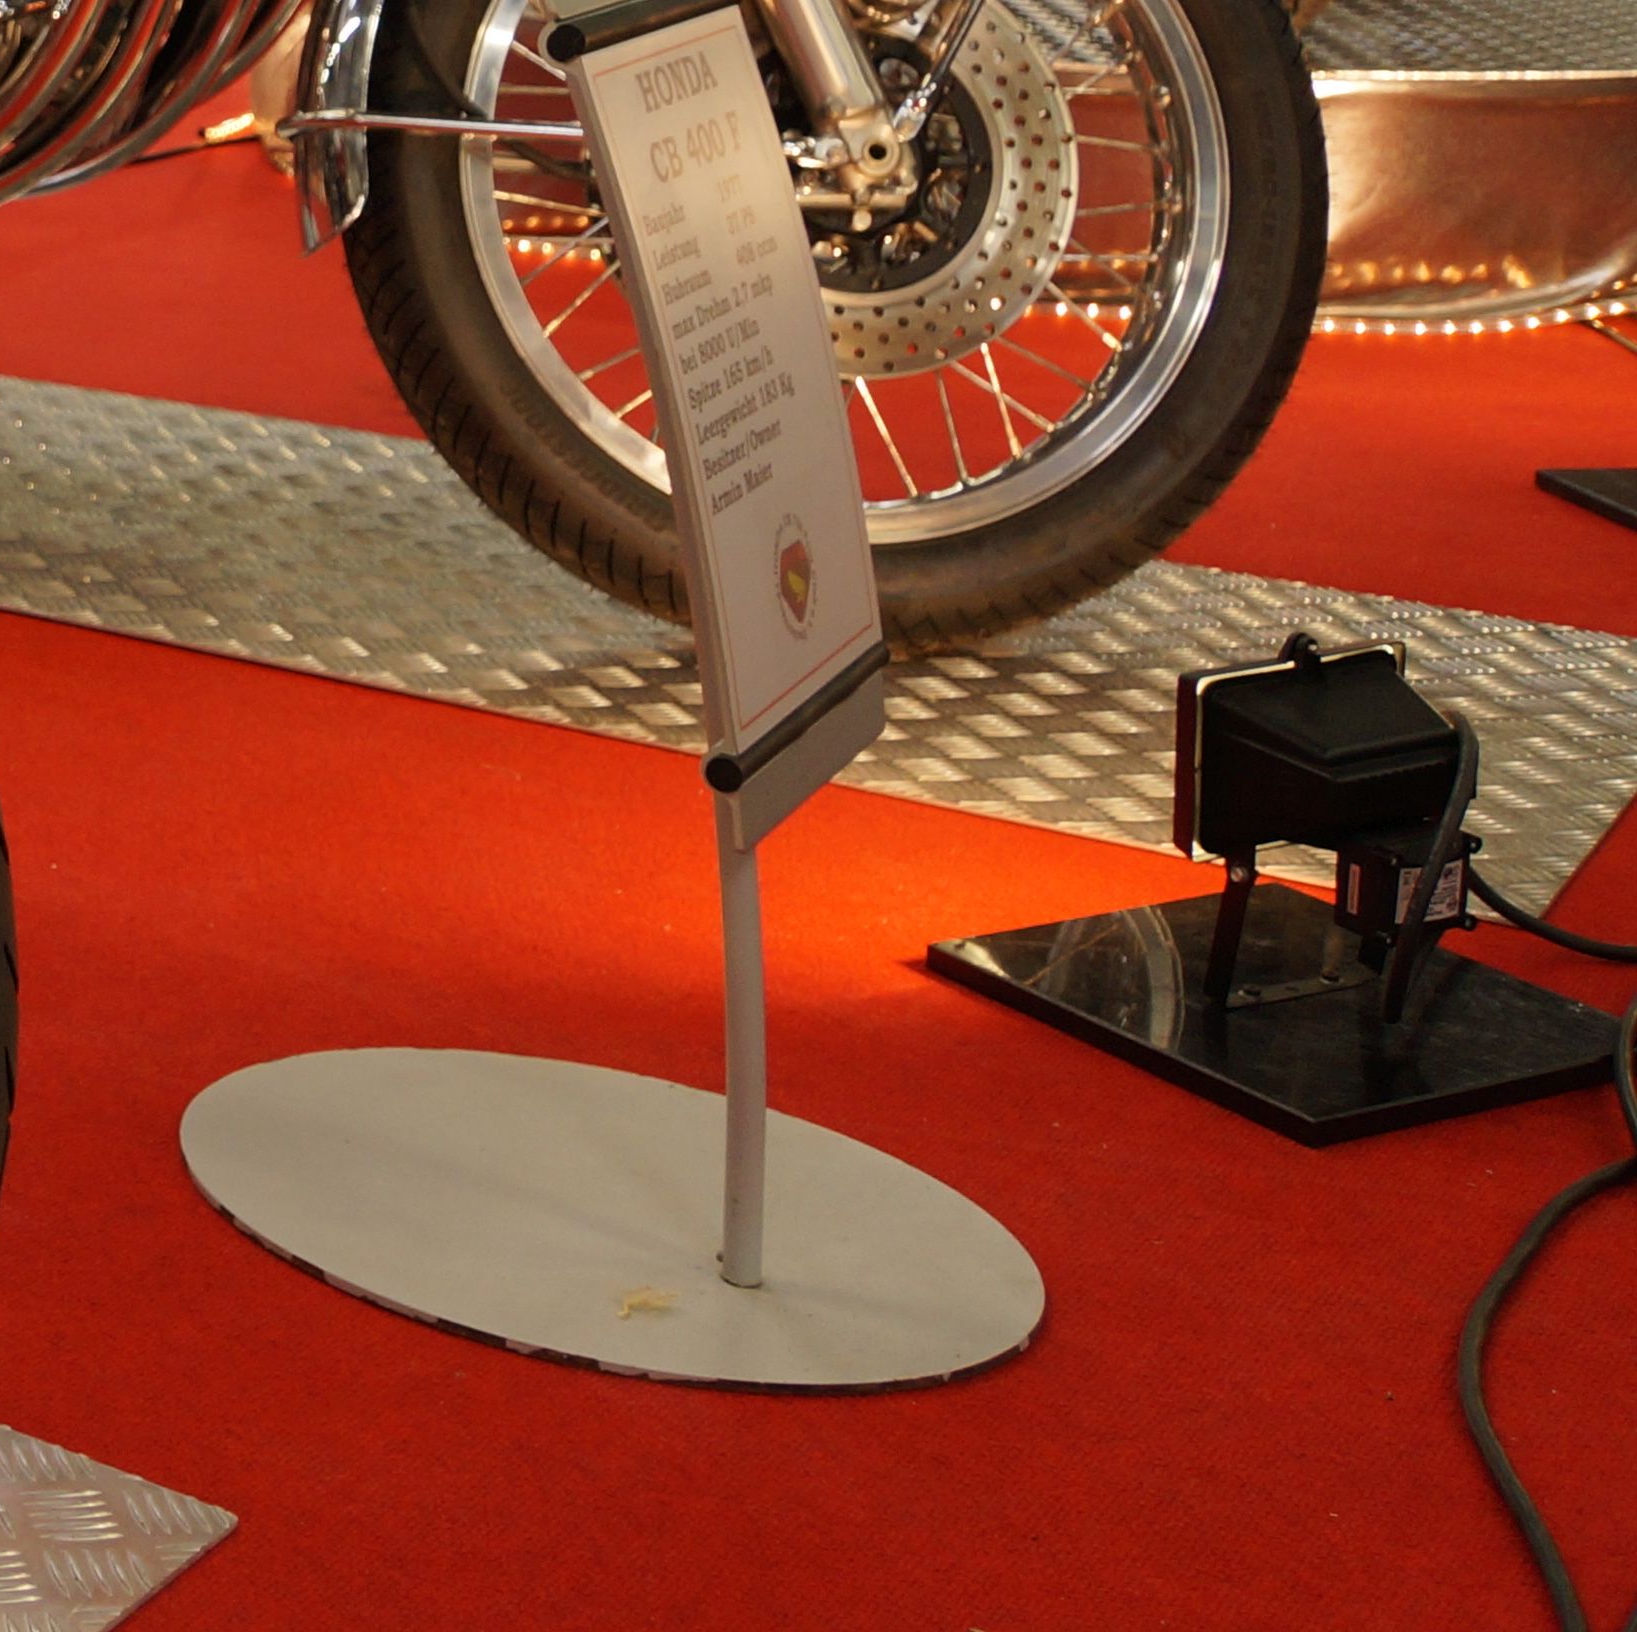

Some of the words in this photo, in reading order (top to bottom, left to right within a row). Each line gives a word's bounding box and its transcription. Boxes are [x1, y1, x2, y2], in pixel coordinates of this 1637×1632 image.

[634, 50, 719, 114] HONDA
[649, 135, 684, 184] CB
[686, 119, 725, 167] 400
[725, 110, 741, 152] F
[653, 237, 701, 271] Leistung
[661, 270, 712, 306] Hubraum
[672, 315, 696, 341] max
[695, 296, 732, 327] Drehm
[679, 347, 698, 375] bei
[697, 332, 726, 365] 8000
[687, 377, 722, 413] Spitze
[743, 344, 773, 377] km/h
[695, 390, 759, 445] Leergewicht
[778, 371, 795, 399] Kg
[702, 419, 782, 481] Besitzer/Owner
[711, 480, 745, 516] Armin
[743, 463, 774, 494] Maier
